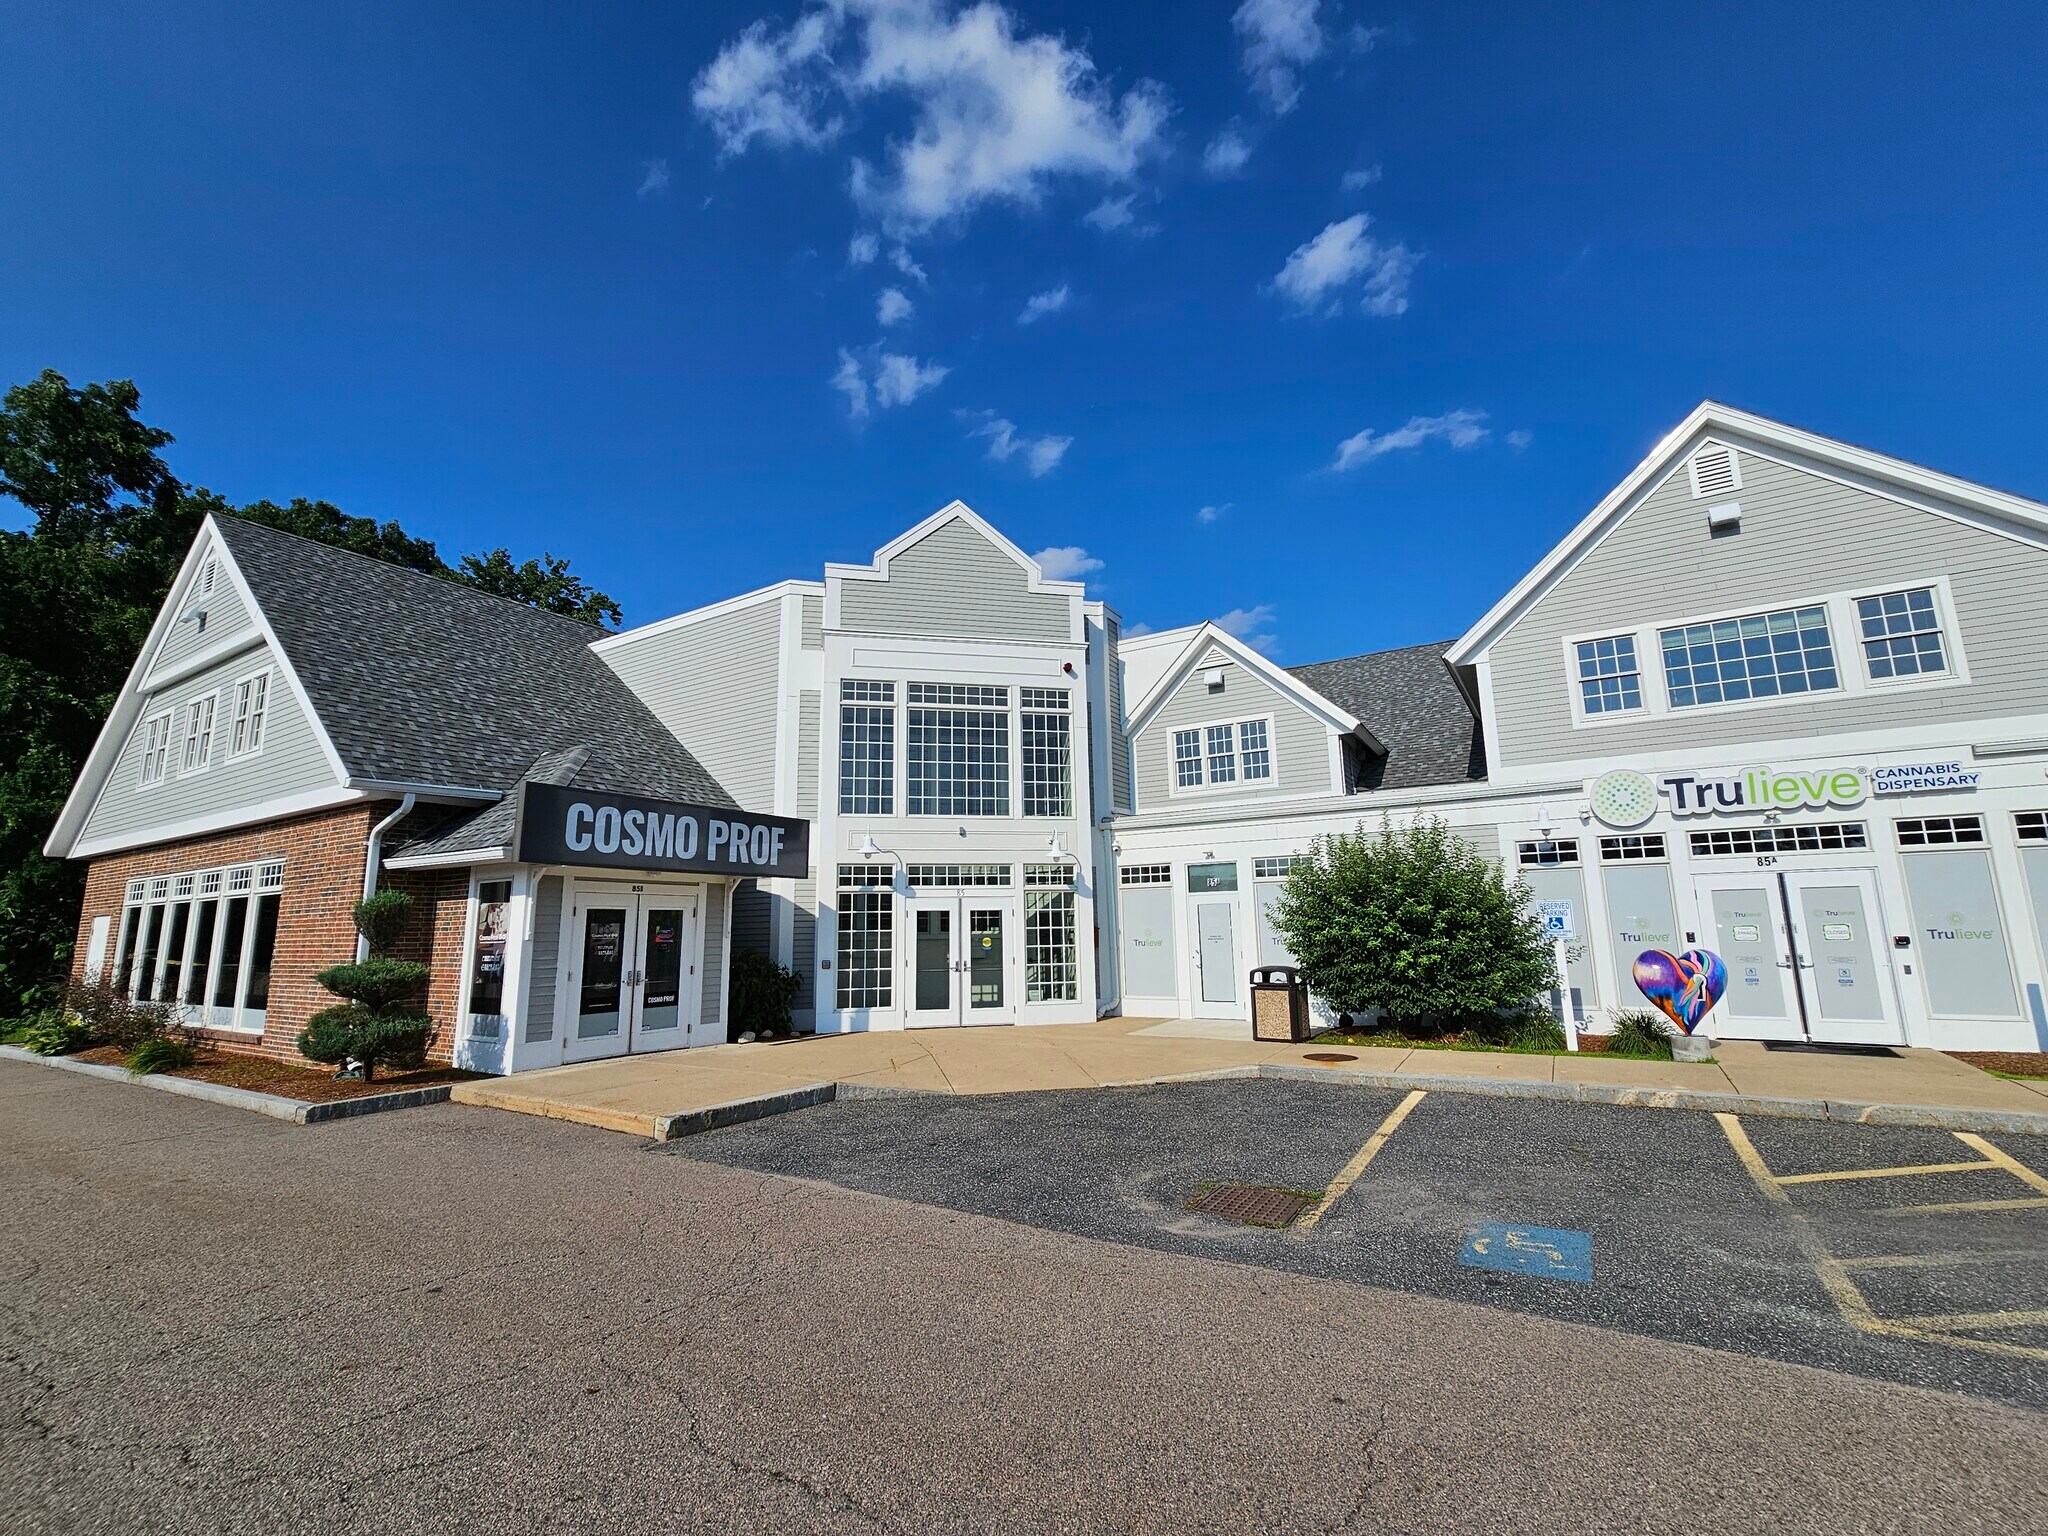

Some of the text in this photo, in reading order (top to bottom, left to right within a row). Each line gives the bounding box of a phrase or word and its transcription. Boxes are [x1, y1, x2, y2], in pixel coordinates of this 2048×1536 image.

[1875, 763, 1960, 779] CANNABIS
[1878, 774, 1979, 790] DISPENSARY
[565, 802, 785, 866] COSMO PROF
[1757, 856, 1778, 867] 85A
[956, 888, 965, 896] 85
[1539, 902, 1570, 910] RESERVED
[1620, 932, 1669, 942] Trulieve
[1927, 928, 1993, 940] Trulieve
[648, 995, 675, 1004] COSMO PROF
